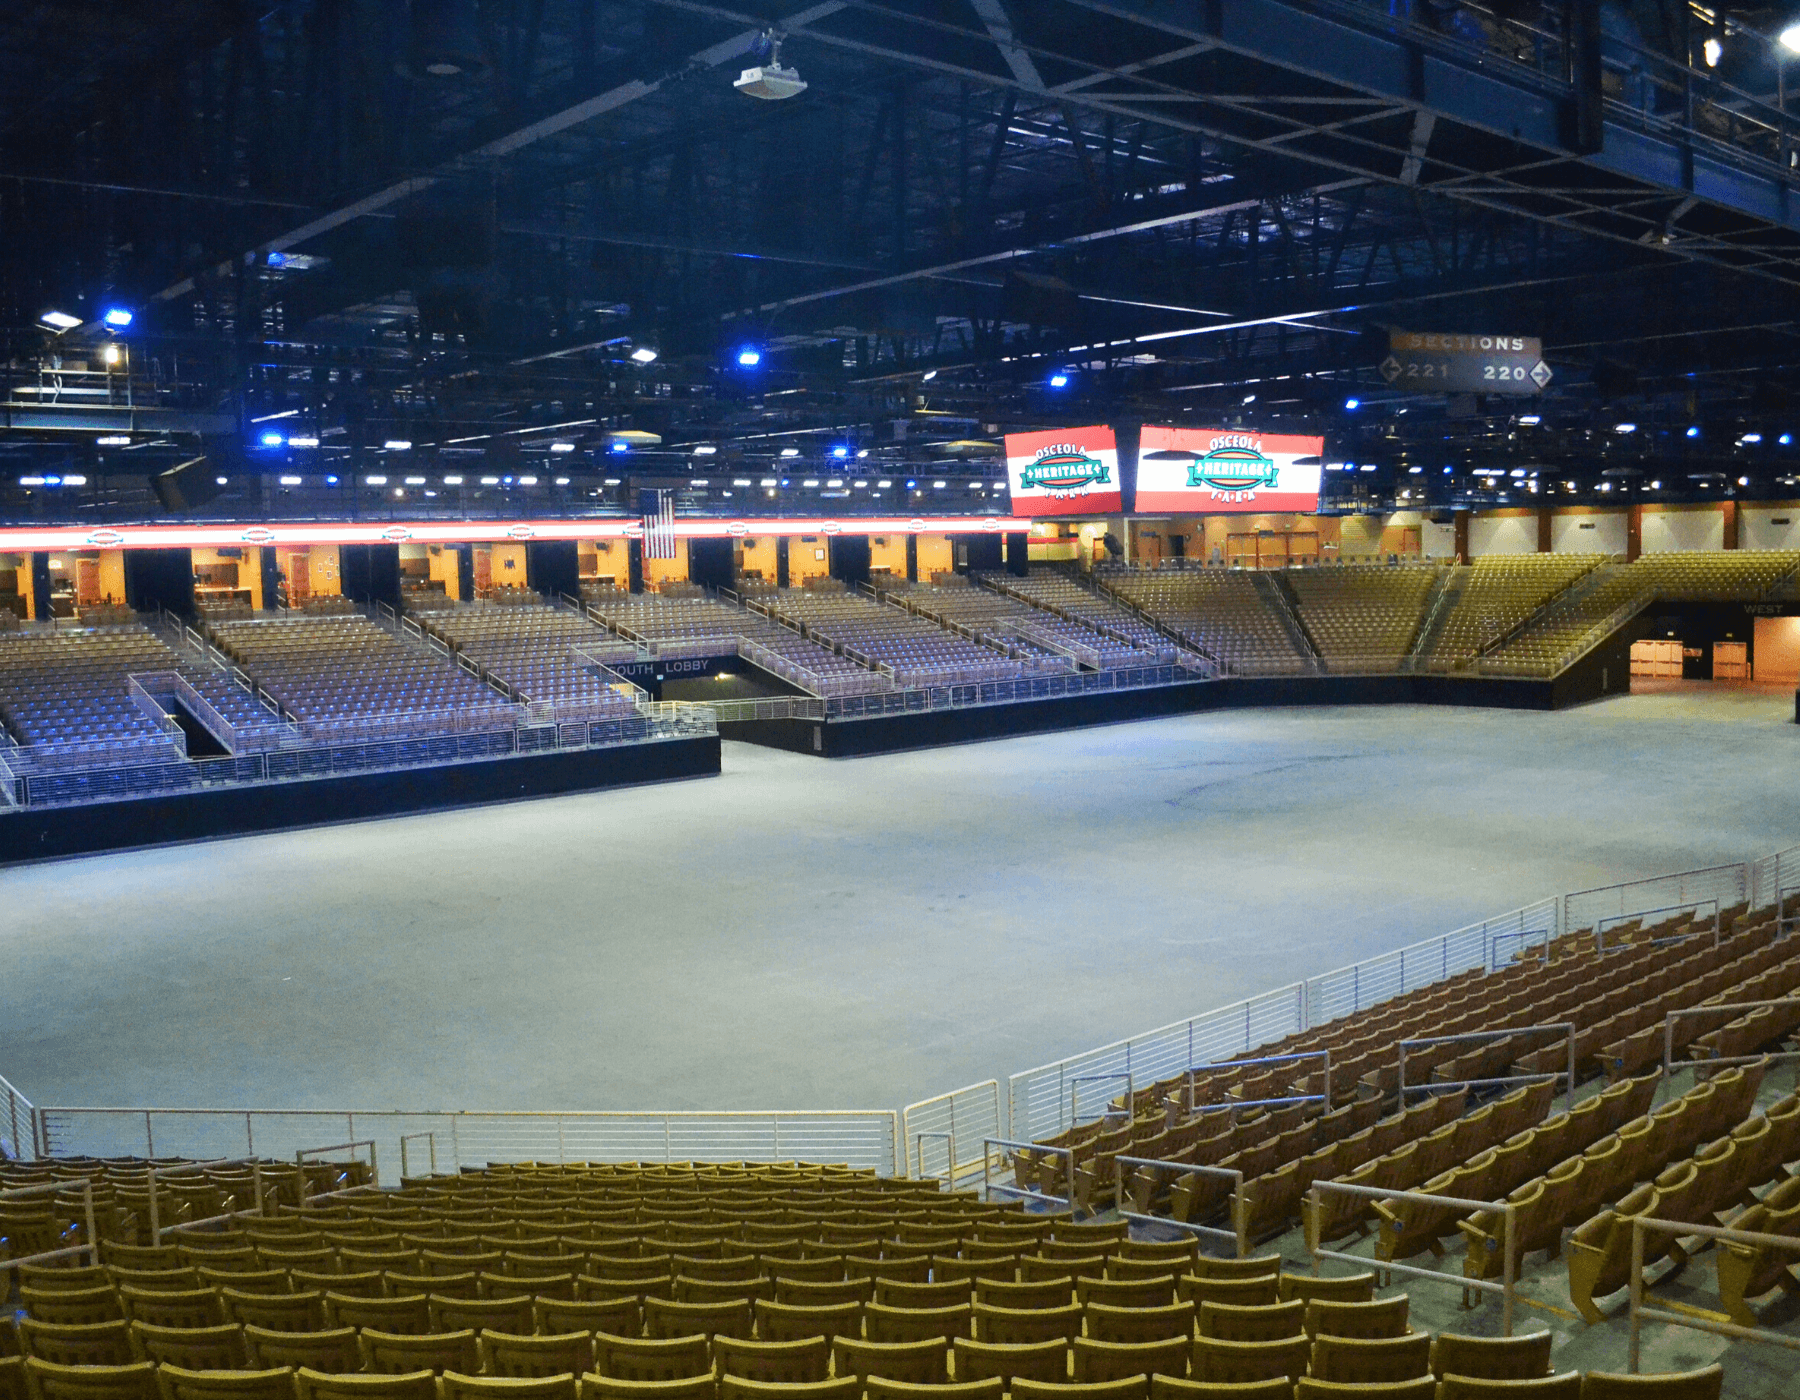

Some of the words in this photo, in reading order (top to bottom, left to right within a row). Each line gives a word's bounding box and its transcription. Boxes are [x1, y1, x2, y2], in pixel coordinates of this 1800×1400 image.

[1411, 333, 1524, 351] SECTIONS
[1407, 363, 1448, 378] 221
[1483, 365, 1526, 381] 220
[1035, 443, 1086, 460] OSCEOLA
[1209, 434, 1262, 453] OSCEOLA
[1033, 463, 1094, 479] HERITAGE
[1203, 461, 1265, 476] HERITAGE
[1743, 604, 1783, 615] WEST
[608, 663, 654, 677] SOUTH
[665, 660, 709, 673] LOBBY
